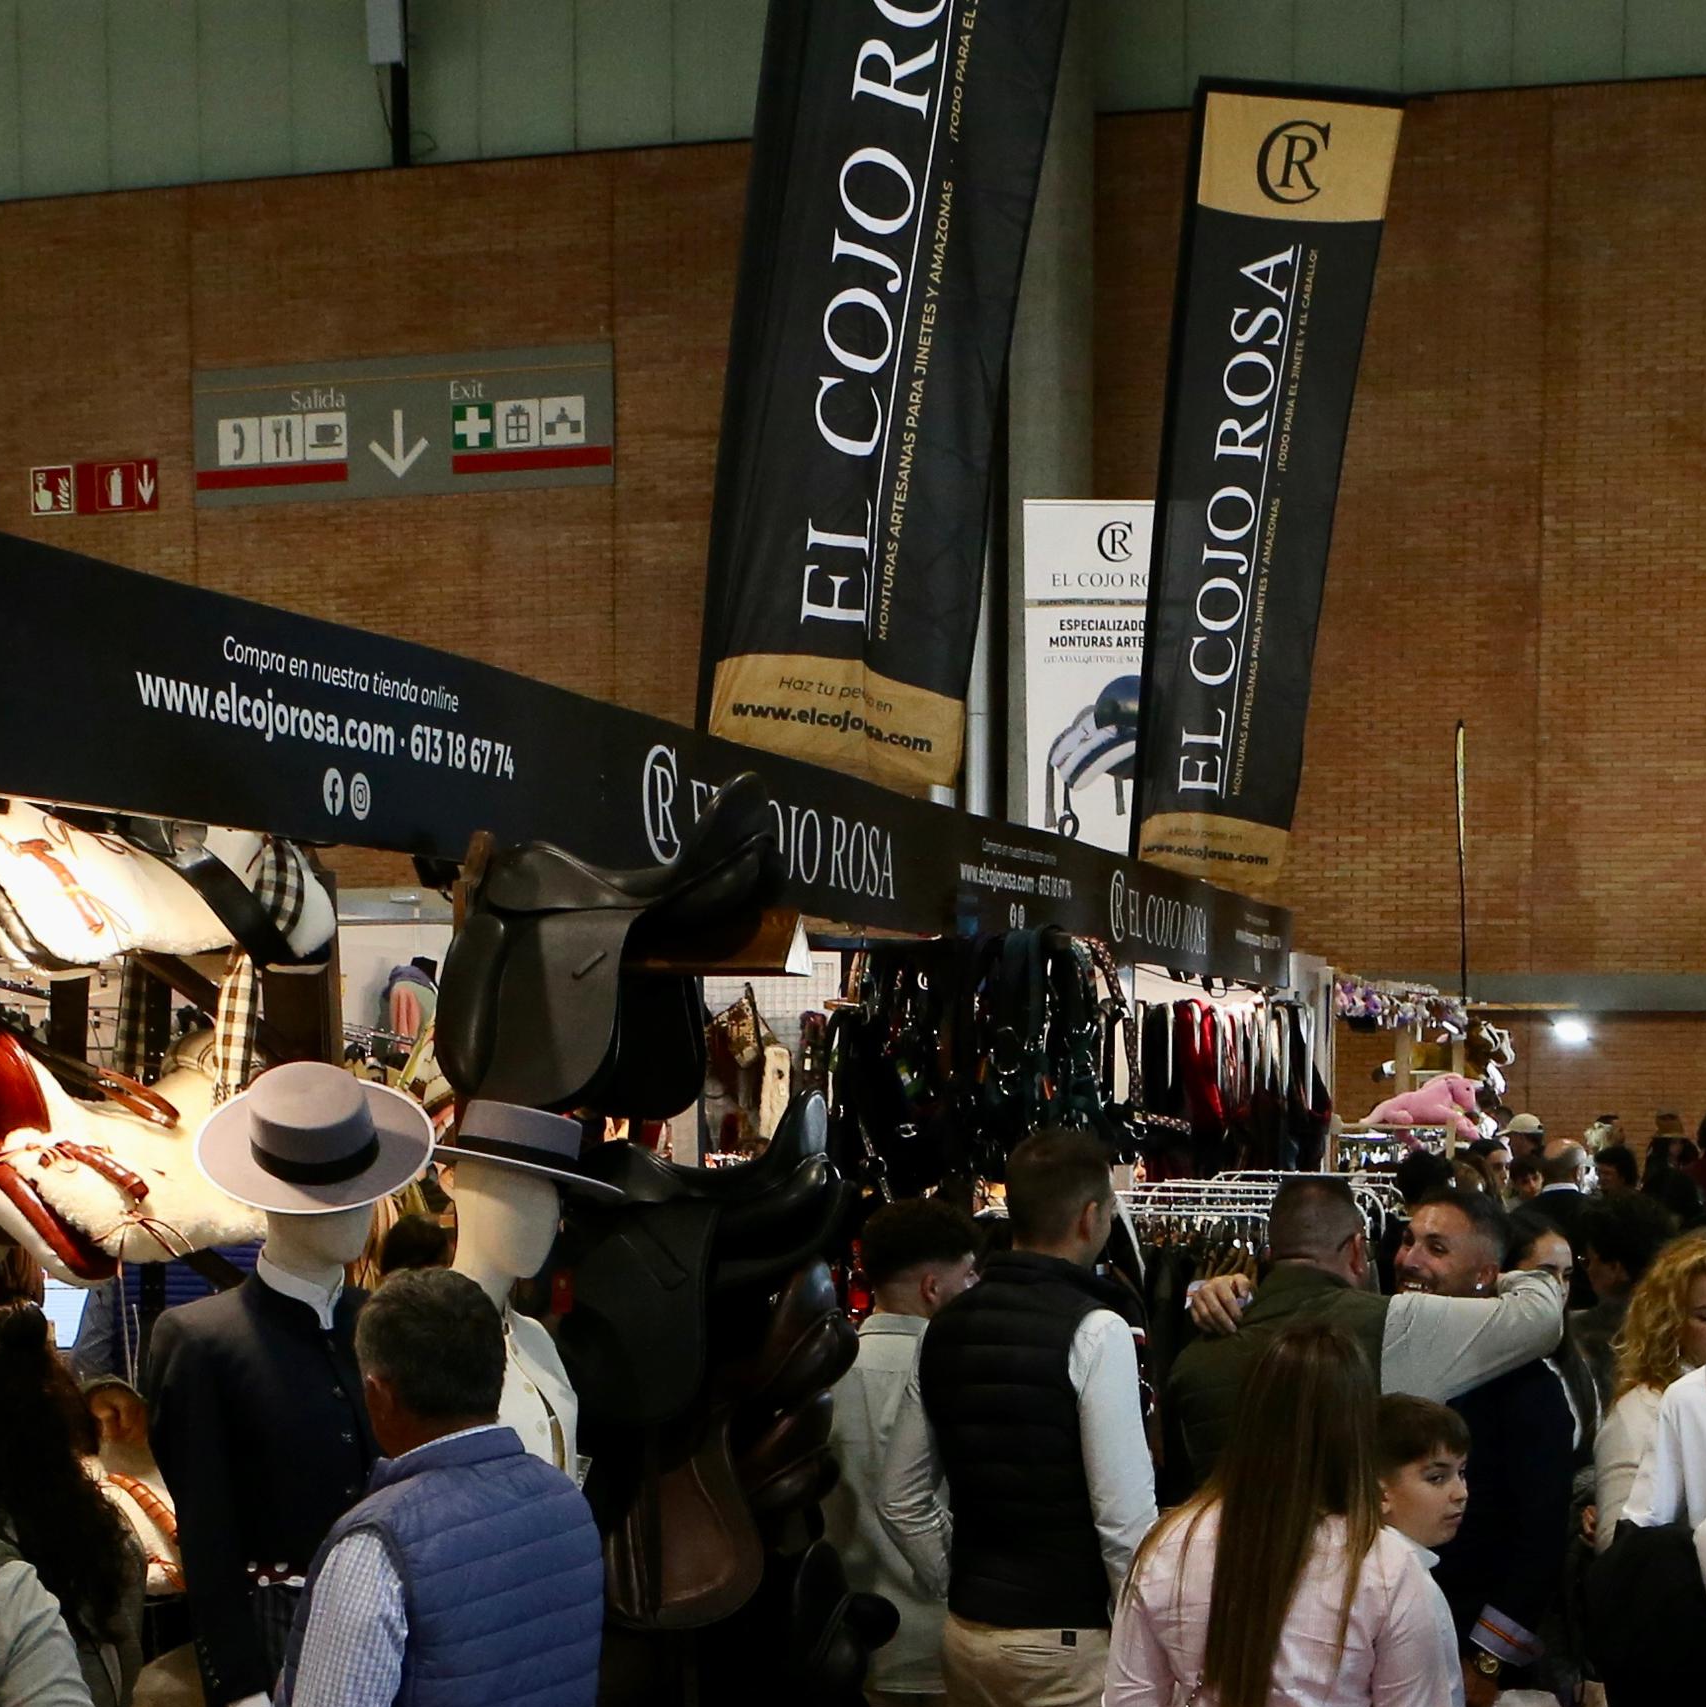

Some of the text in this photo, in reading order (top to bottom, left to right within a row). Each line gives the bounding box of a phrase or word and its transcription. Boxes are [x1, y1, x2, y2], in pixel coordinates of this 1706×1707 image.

[962, 10, 976, 30] EL
[955, 35, 970, 81] PARA
[931, 181, 953, 284] AMAZONAS
[815, 147, 915, 456] COJO
[925, 283, 939, 298] Y
[916, 302, 937, 375] JINETES
[1214, 244, 1295, 463] ROSA
[290, 386, 347, 412] Salida
[449, 379, 485, 401] Exit
[906, 378, 925, 429] PARA
[1283, 398, 1296, 431] PARA
[891, 431, 916, 537] ARTESANAS
[800, 498, 872, 624] EL
[1262, 497, 1281, 565] AMAZONAS
[877, 539, 899, 640] MONTURAS
[1052, 573, 1072, 587] EL
[1077, 572, 1124, 588] COJO
[1190, 485, 1258, 686] COJO
[1255, 577, 1269, 624] JINETES
[223, 635, 460, 713] Compra en nuestra tienda online
[1049, 636, 1113, 648] MONTURAS
[1251, 625, 1263, 659] PARA
[136, 671, 515, 780] www.elcojorosa.com 613 18 67 74
[778, 676, 814, 693] Haz
[817, 682, 834, 696] tu
[876, 700, 893, 715] en
[1241, 660, 1259, 729] ARTESANAS
[1177, 708, 1226, 796] EL
[1232, 731, 1249, 797] MONTURAS
[829, 816, 895, 900] ROSA
[1129, 889, 1142, 938] EL
[1146, 894, 1181, 949] COJO
